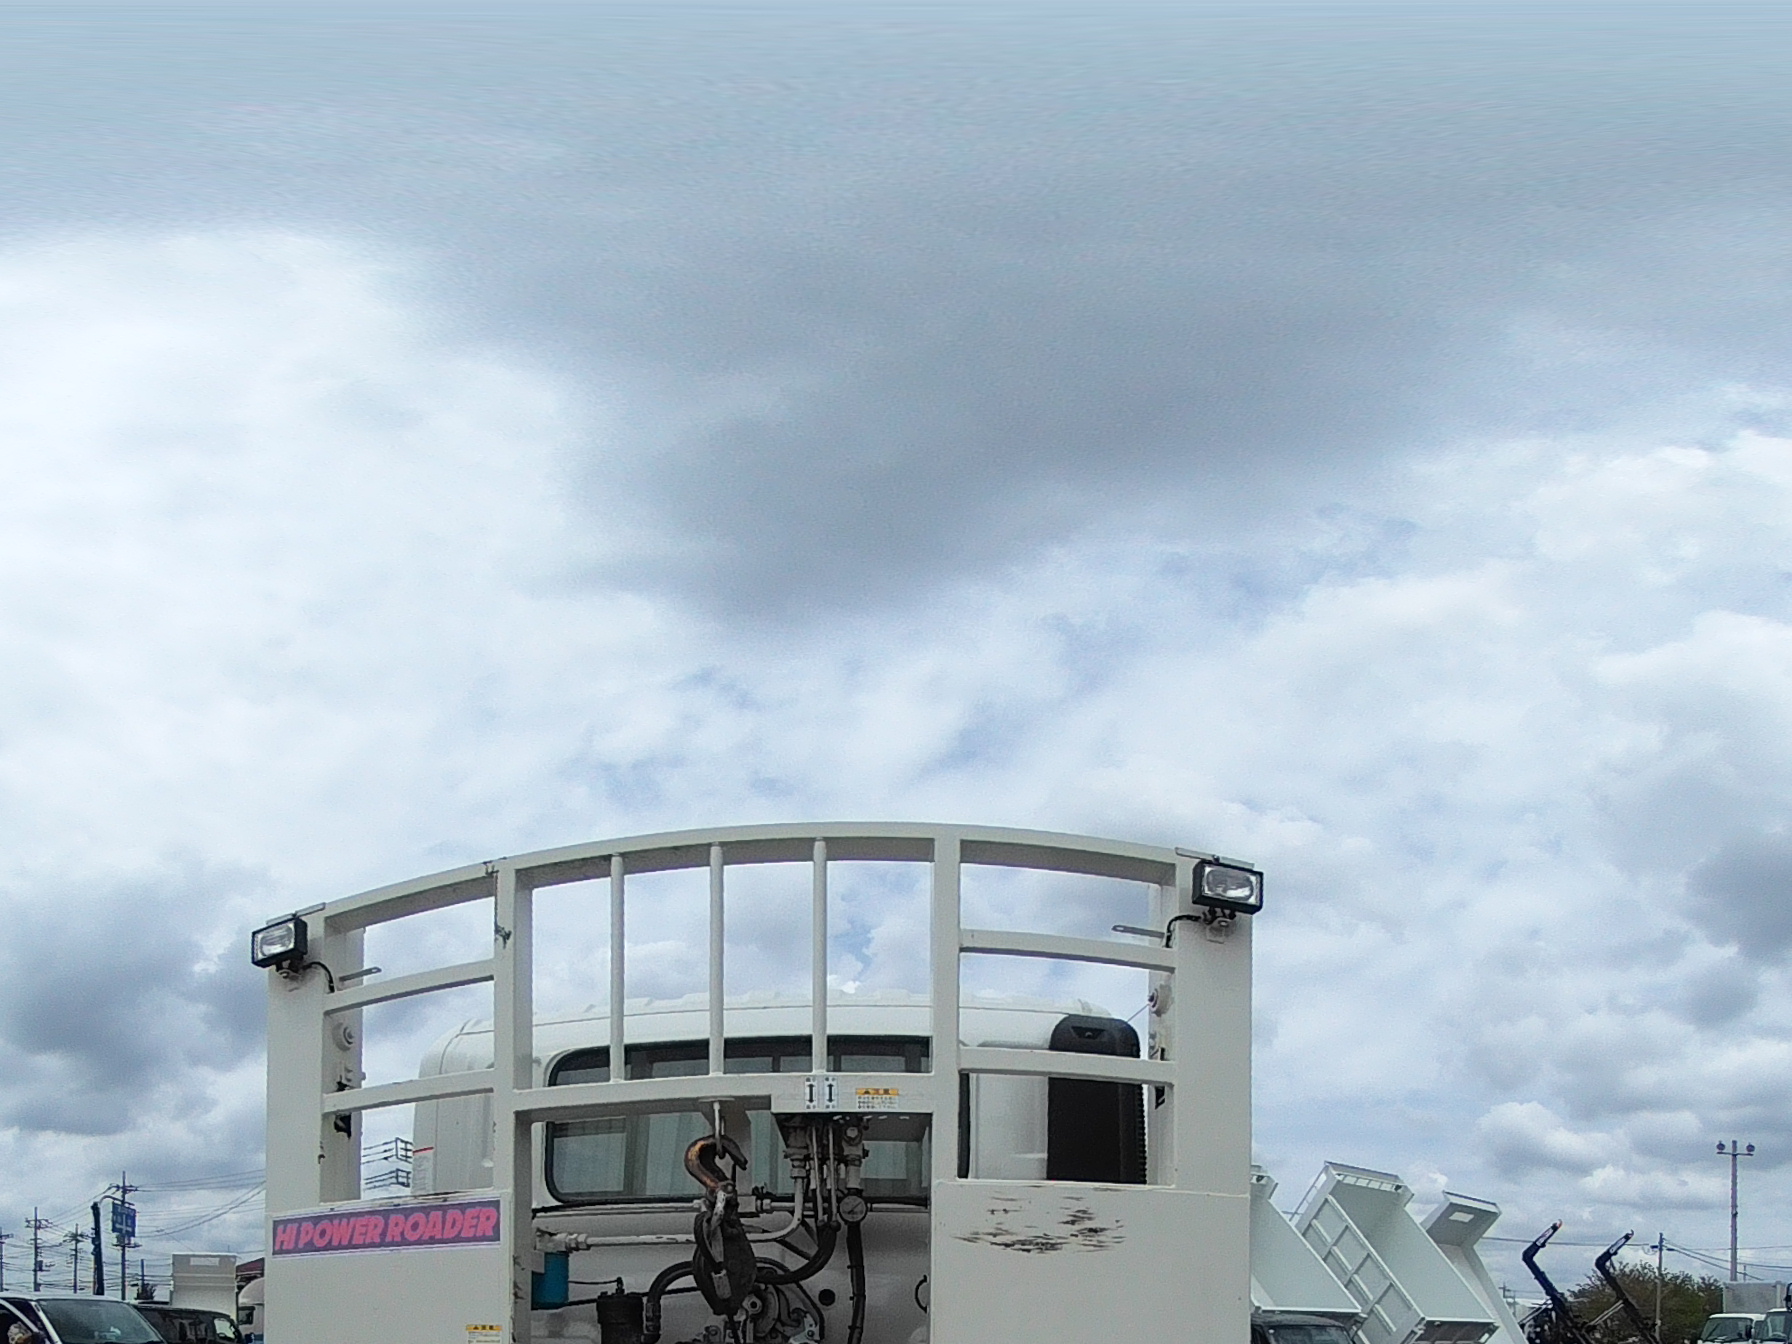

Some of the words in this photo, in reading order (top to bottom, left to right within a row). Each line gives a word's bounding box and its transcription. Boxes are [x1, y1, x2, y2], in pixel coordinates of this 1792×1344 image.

[275, 1223, 297, 1250] HI
[298, 1214, 384, 1249] POWER
[385, 1206, 497, 1242] ROADER
